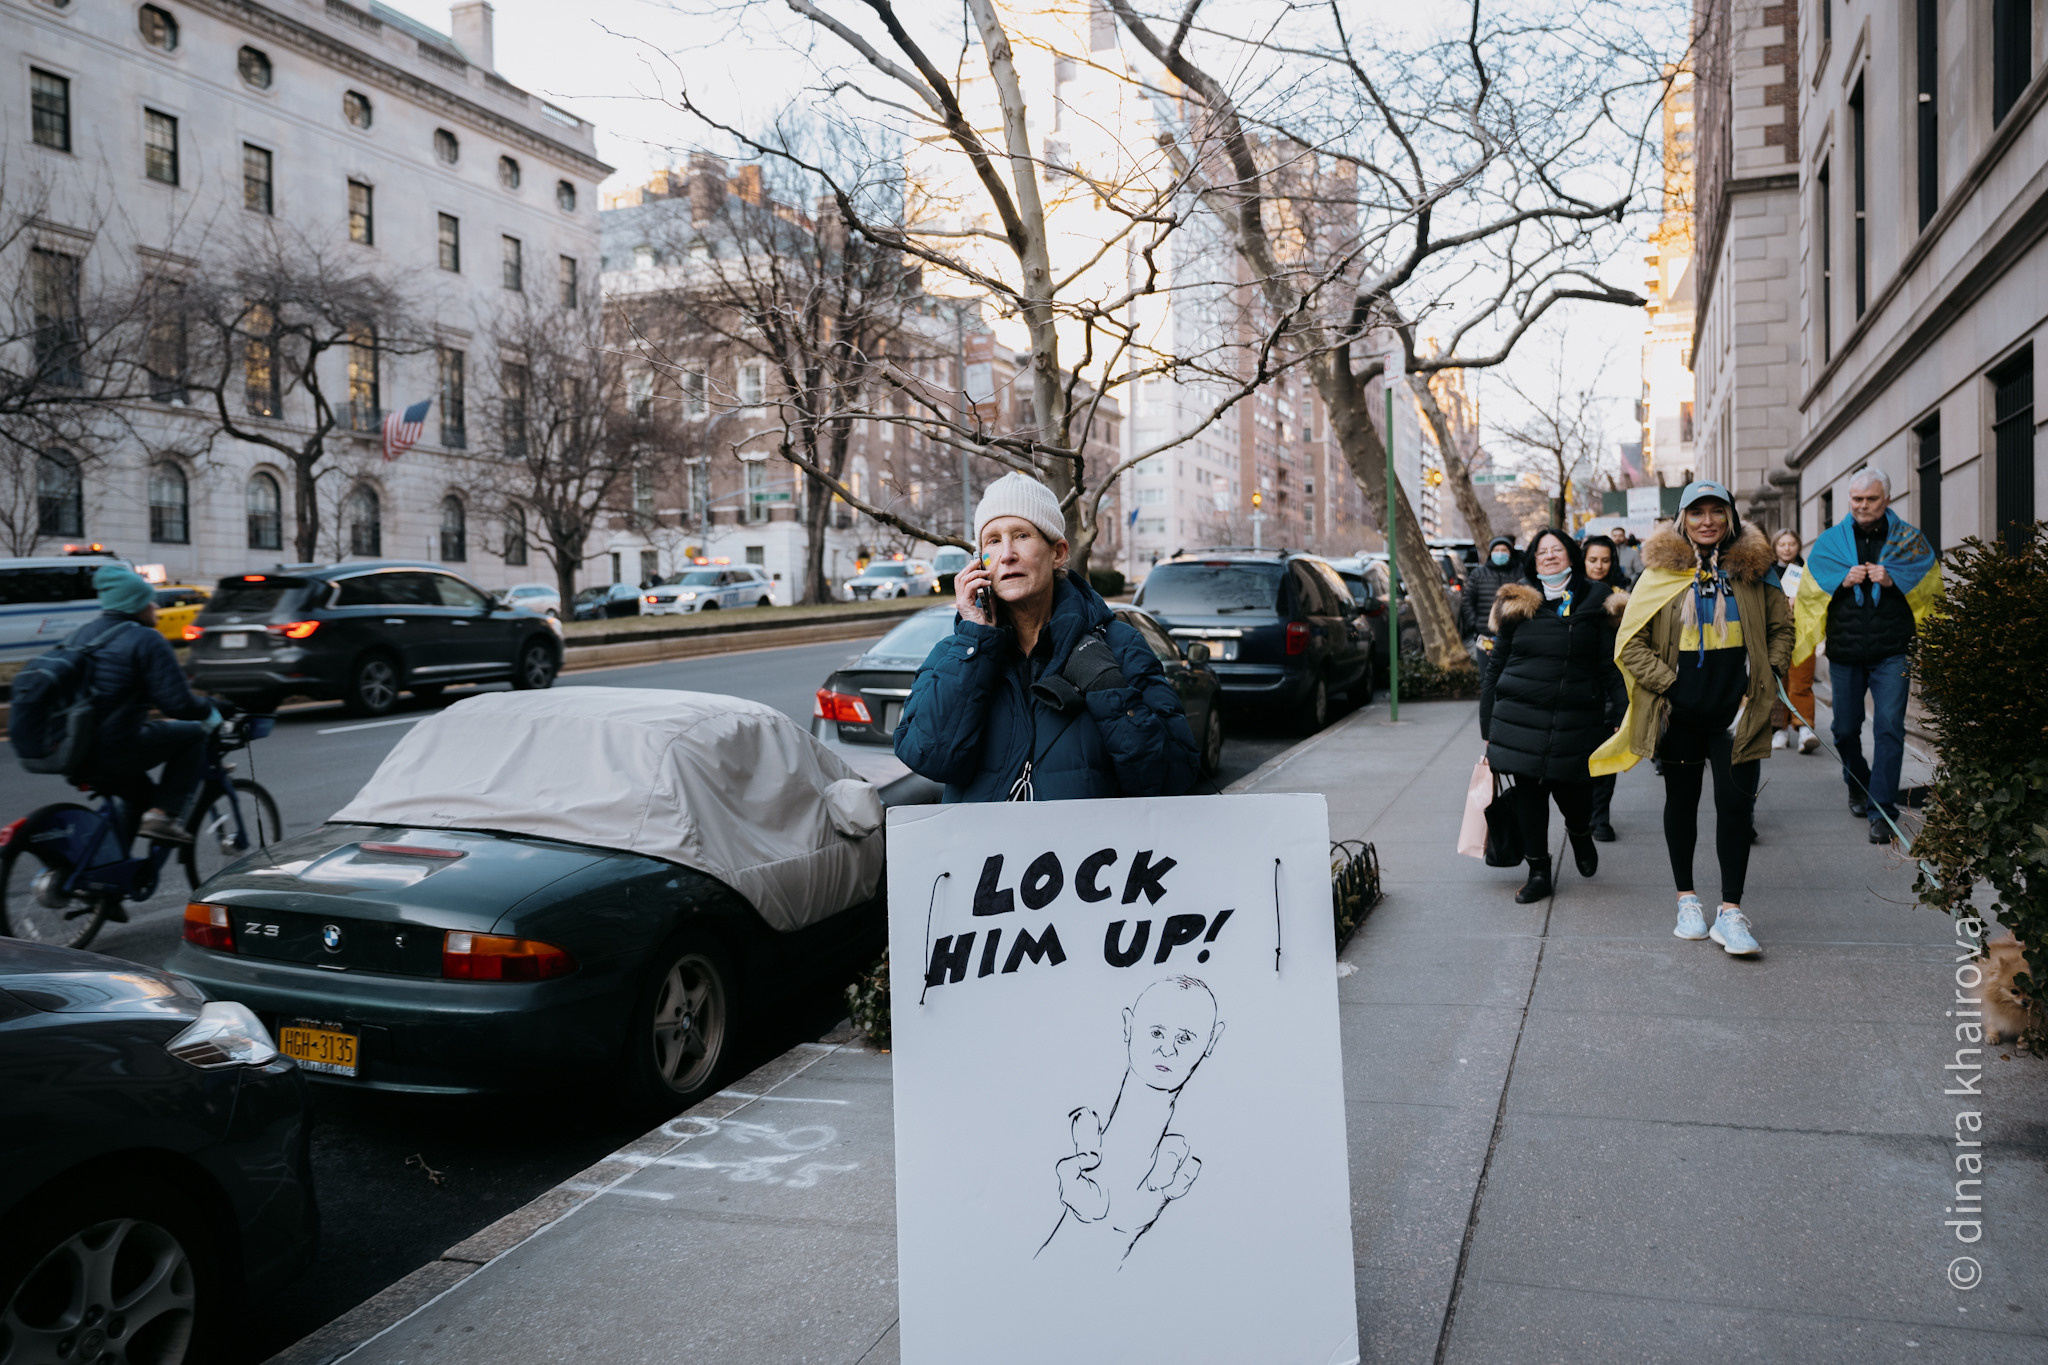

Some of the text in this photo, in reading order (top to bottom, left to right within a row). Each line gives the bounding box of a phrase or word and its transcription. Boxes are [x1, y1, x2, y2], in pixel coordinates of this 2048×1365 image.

[972, 848, 1177, 916] LOCK
[244, 922, 280, 937] Z3
[926, 908, 1235, 988] HIM UP!
